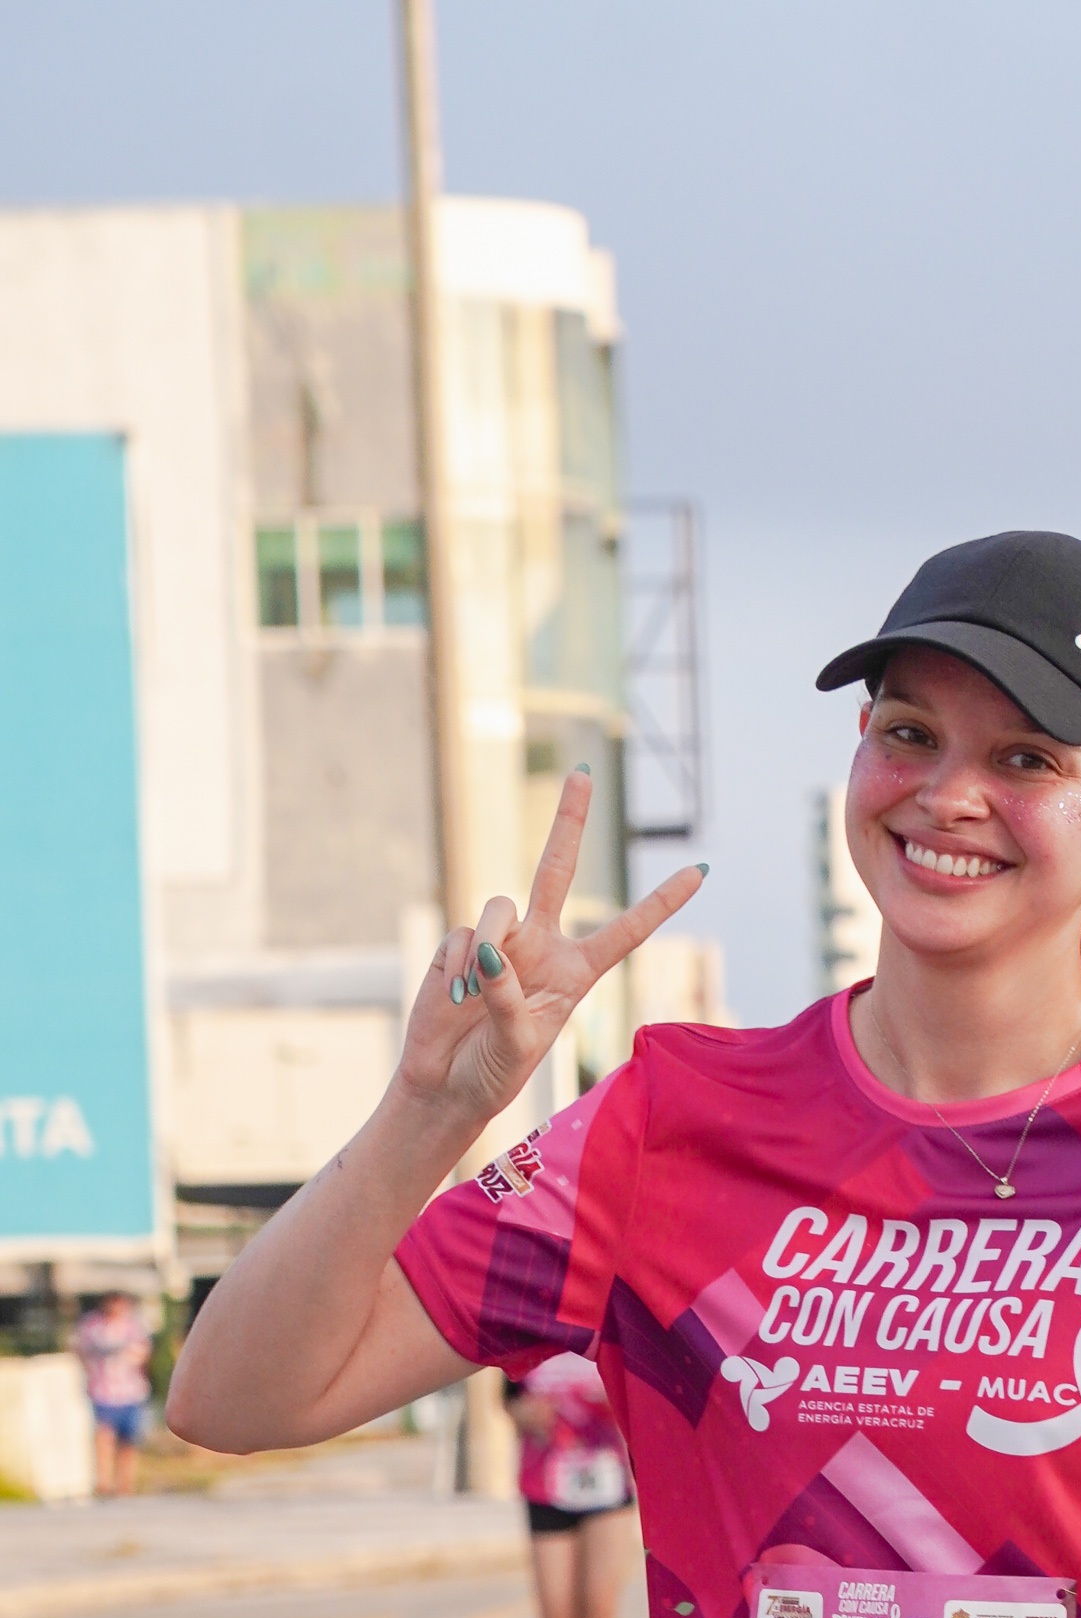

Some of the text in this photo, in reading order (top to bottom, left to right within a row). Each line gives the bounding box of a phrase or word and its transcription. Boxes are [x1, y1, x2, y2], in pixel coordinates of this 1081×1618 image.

[0, 1096, 96, 1158] TA
[758, 1285, 1055, 1359] CON CAUSA
[800, 1364, 920, 1397] AEEV
[976, 1376, 1079, 1407] MUAC
[798, 1400, 935, 1417] AGENCIA ESTATAL DE
[798, 1412, 925, 1429] ENERGÍA VERACRUZ
[838, 1582, 896, 1602] CARRERA
[838, 1600, 889, 1615] CON CAUSA
